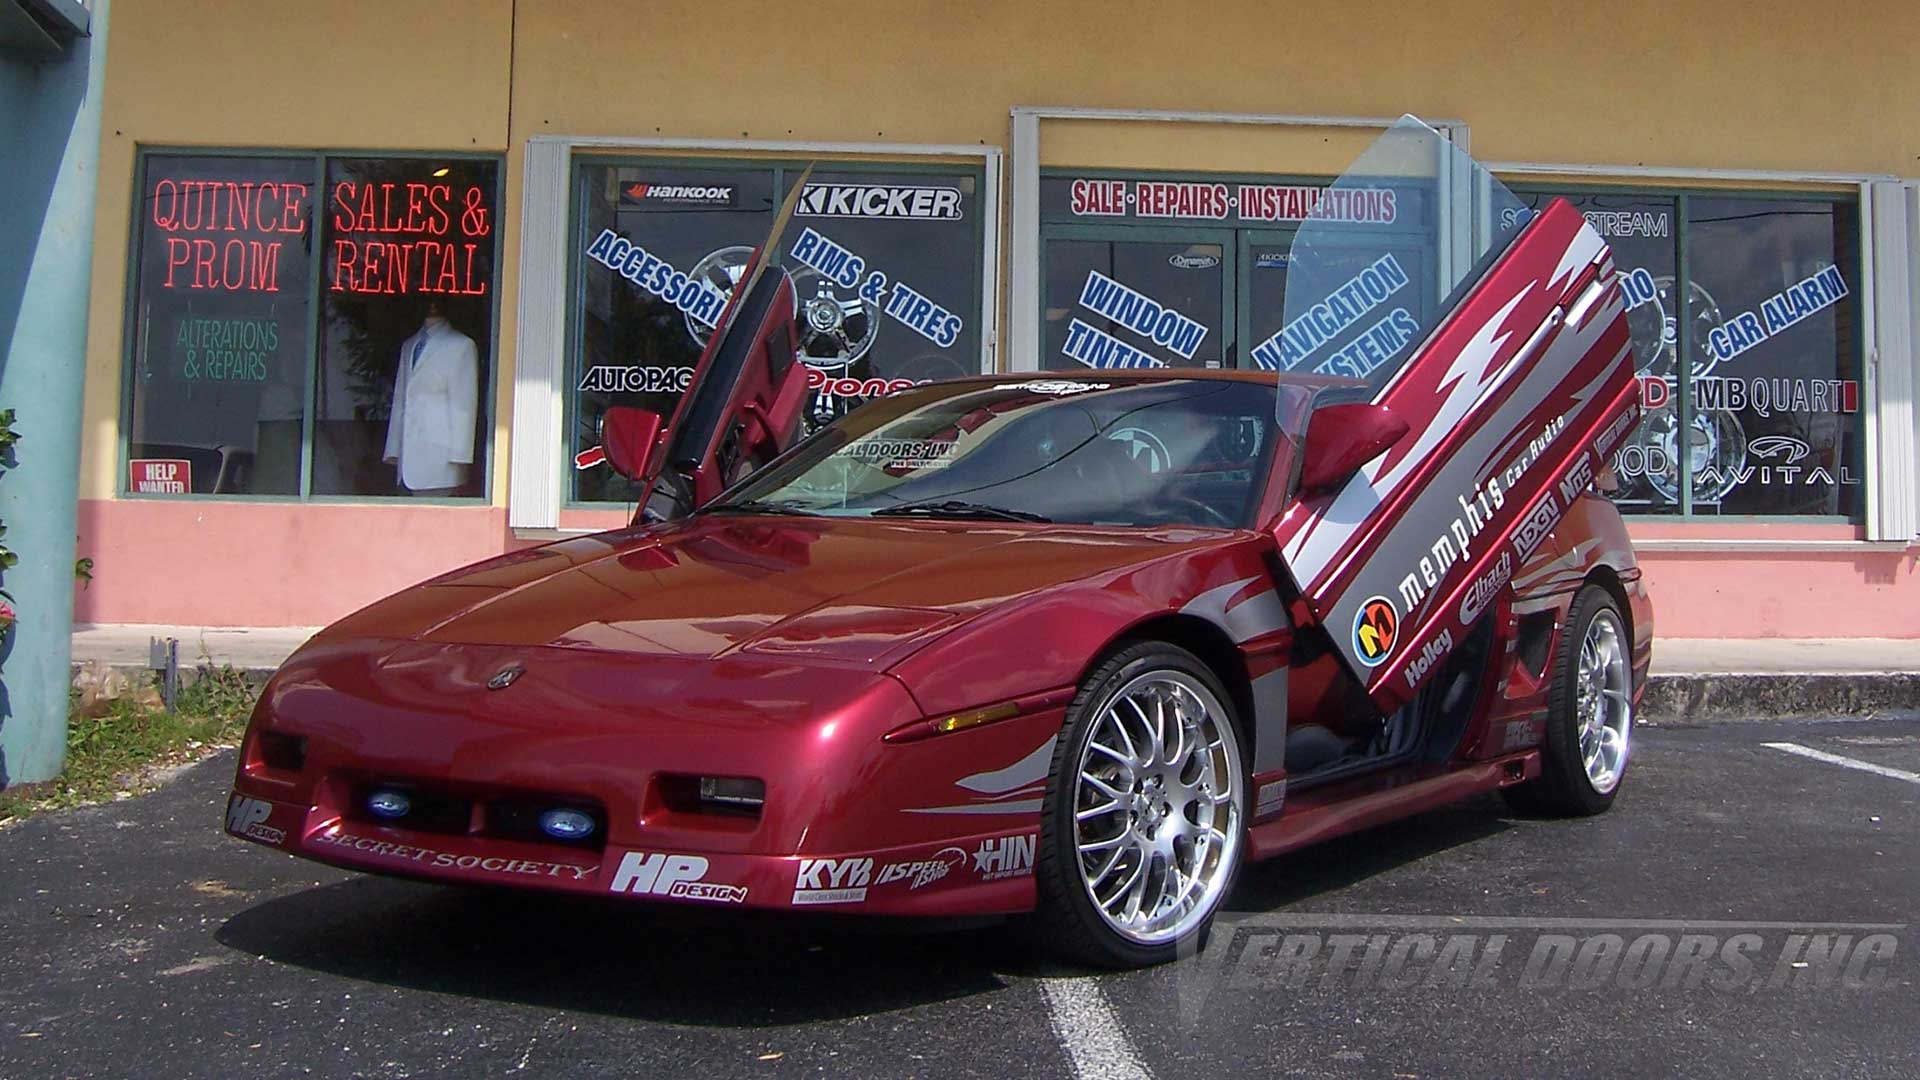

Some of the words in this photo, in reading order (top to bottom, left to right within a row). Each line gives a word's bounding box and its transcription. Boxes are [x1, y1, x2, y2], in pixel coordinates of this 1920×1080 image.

[153, 179, 307, 233] QUINCE
[335, 182, 449, 236] SALES
[461, 187, 490, 237] &
[1072, 179, 1127, 215] SALE
[1135, 182, 1228, 219] REPAIRS
[1238, 186, 1397, 224] INSTALLATIONS
[164, 238, 281, 292] PROM
[331, 239, 485, 294] RENTAL
[587, 230, 728, 328] ACCESSORI
[790, 228, 865, 288] RIMS
[860, 272, 887, 306] &
[885, 283, 962, 347] TIRES
[177, 319, 279, 352] ALTERATIONS
[1079, 271, 1207, 359] WINDOW
[1251, 253, 1409, 370] NAVIGATION
[1709, 311, 1767, 361] CAR
[1760, 265, 1849, 337] ALARM
[184, 351, 200, 379] &
[204, 350, 267, 381] REPAIRS
[145, 463, 177, 481] HELP
[1558, 459, 1593, 506] NOS
[1697, 466, 1861, 485] AVITAL
[1398, 476, 1506, 613] memphis
[1505, 461, 1529, 489] Car
[1529, 415, 1565, 459] Audio
[1404, 628, 1453, 688] Holley
[228, 798, 272, 833] HP
[248, 825, 288, 843] DESIGN
[317, 832, 436, 861] SECRET
[432, 853, 601, 880] SOCIETY
[610, 851, 711, 896] HP
[796, 857, 874, 889] KYB
[671, 883, 748, 903] DESIGN
